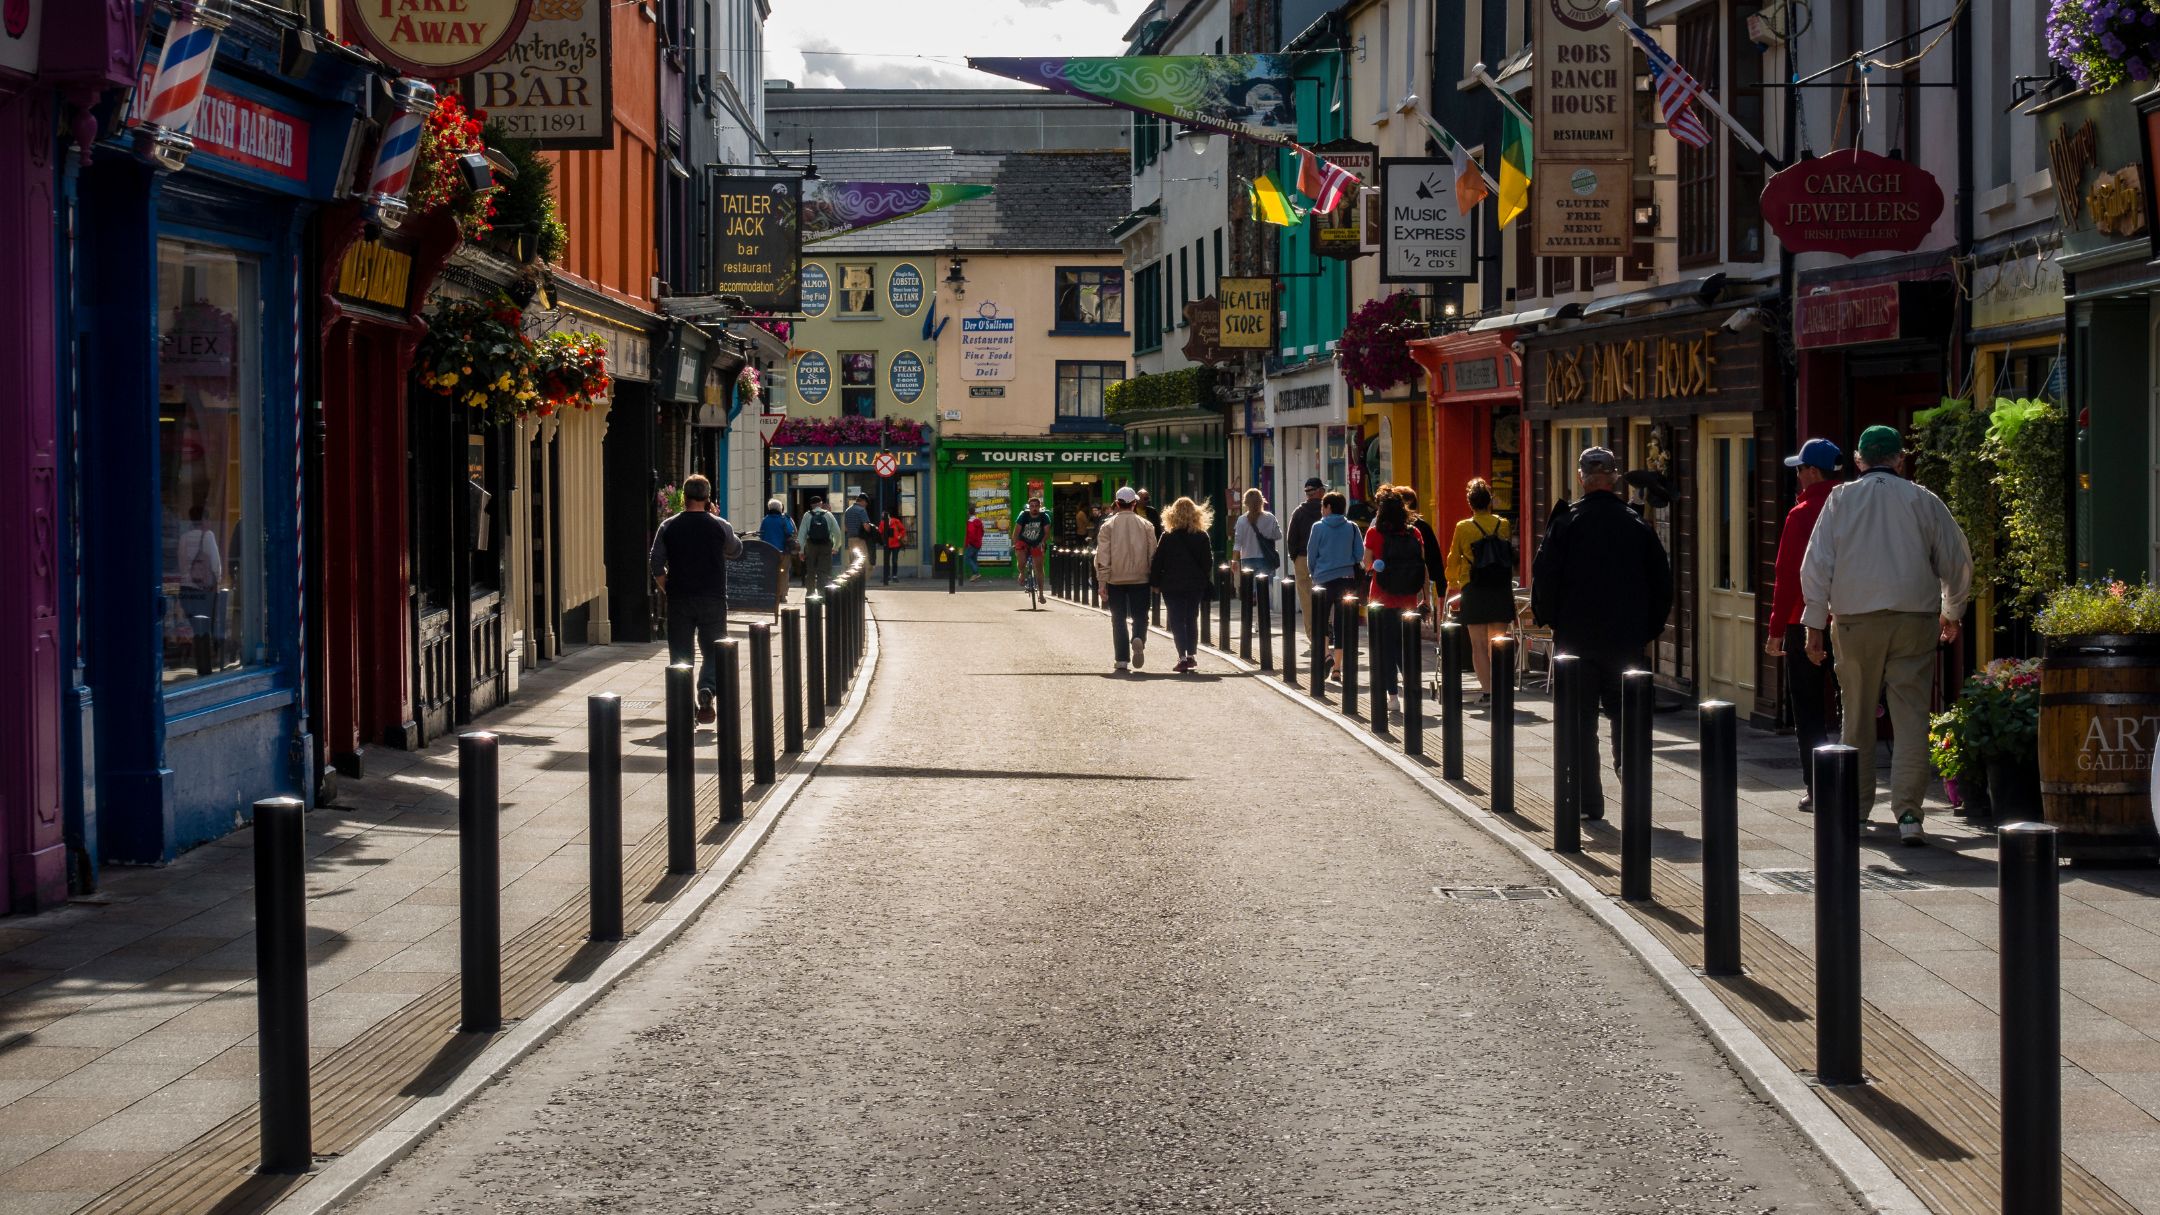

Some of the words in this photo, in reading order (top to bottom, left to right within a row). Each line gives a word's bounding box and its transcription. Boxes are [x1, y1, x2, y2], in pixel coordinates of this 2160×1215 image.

[389, 15, 488, 44] AWAY
[493, 31, 597, 74] urtney's
[1558, 44, 1610, 63] ROBS
[1551, 69, 1617, 89] RANCH
[479, 71, 592, 108] BAR
[1552, 94, 1617, 114] HOUSE
[541, 115, 585, 131] 1891
[1173, 99, 1193, 120] The
[1195, 110, 1226, 128] Town
[1227, 118, 1238, 131] in
[239, 107, 293, 167] BARBER
[1553, 129, 1614, 140] RESTAURANT
[1804, 173, 1902, 194] CARAGH
[720, 194, 771, 214] TATLER
[1556, 199, 1610, 208] GLUTEN
[1566, 212, 1601, 220] FREE
[1785, 202, 1920, 226] JEWELLERS
[726, 217, 764, 236] JACK
[1563, 225, 1603, 233] MENU
[737, 242, 759, 255] bar
[1546, 237, 1621, 246] AVAILABLE
[1426, 249, 1457, 258] PRICE
[723, 262, 772, 274] restaurant
[1428, 259, 1455, 268] CD'S
[719, 281, 775, 293] accommodation
[892, 278, 920, 286] LOBSTER
[1221, 290, 1270, 310] HEALTH
[1837, 295, 1890, 331] JEWELLERS
[964, 321, 977, 330] Der
[978, 320, 1013, 330] O'Sullivan
[1225, 314, 1266, 334] STORE
[962, 335, 1014, 344] Restaurant
[965, 351, 985, 359] Fine
[988, 351, 1013, 359] Foods
[976, 368, 998, 376] Deli
[1591, 338, 1646, 404] RANCH
[1653, 327, 1721, 400] HOUSE
[981, 451, 1055, 462] TOURIST
[1061, 451, 1121, 462] OFFICE
